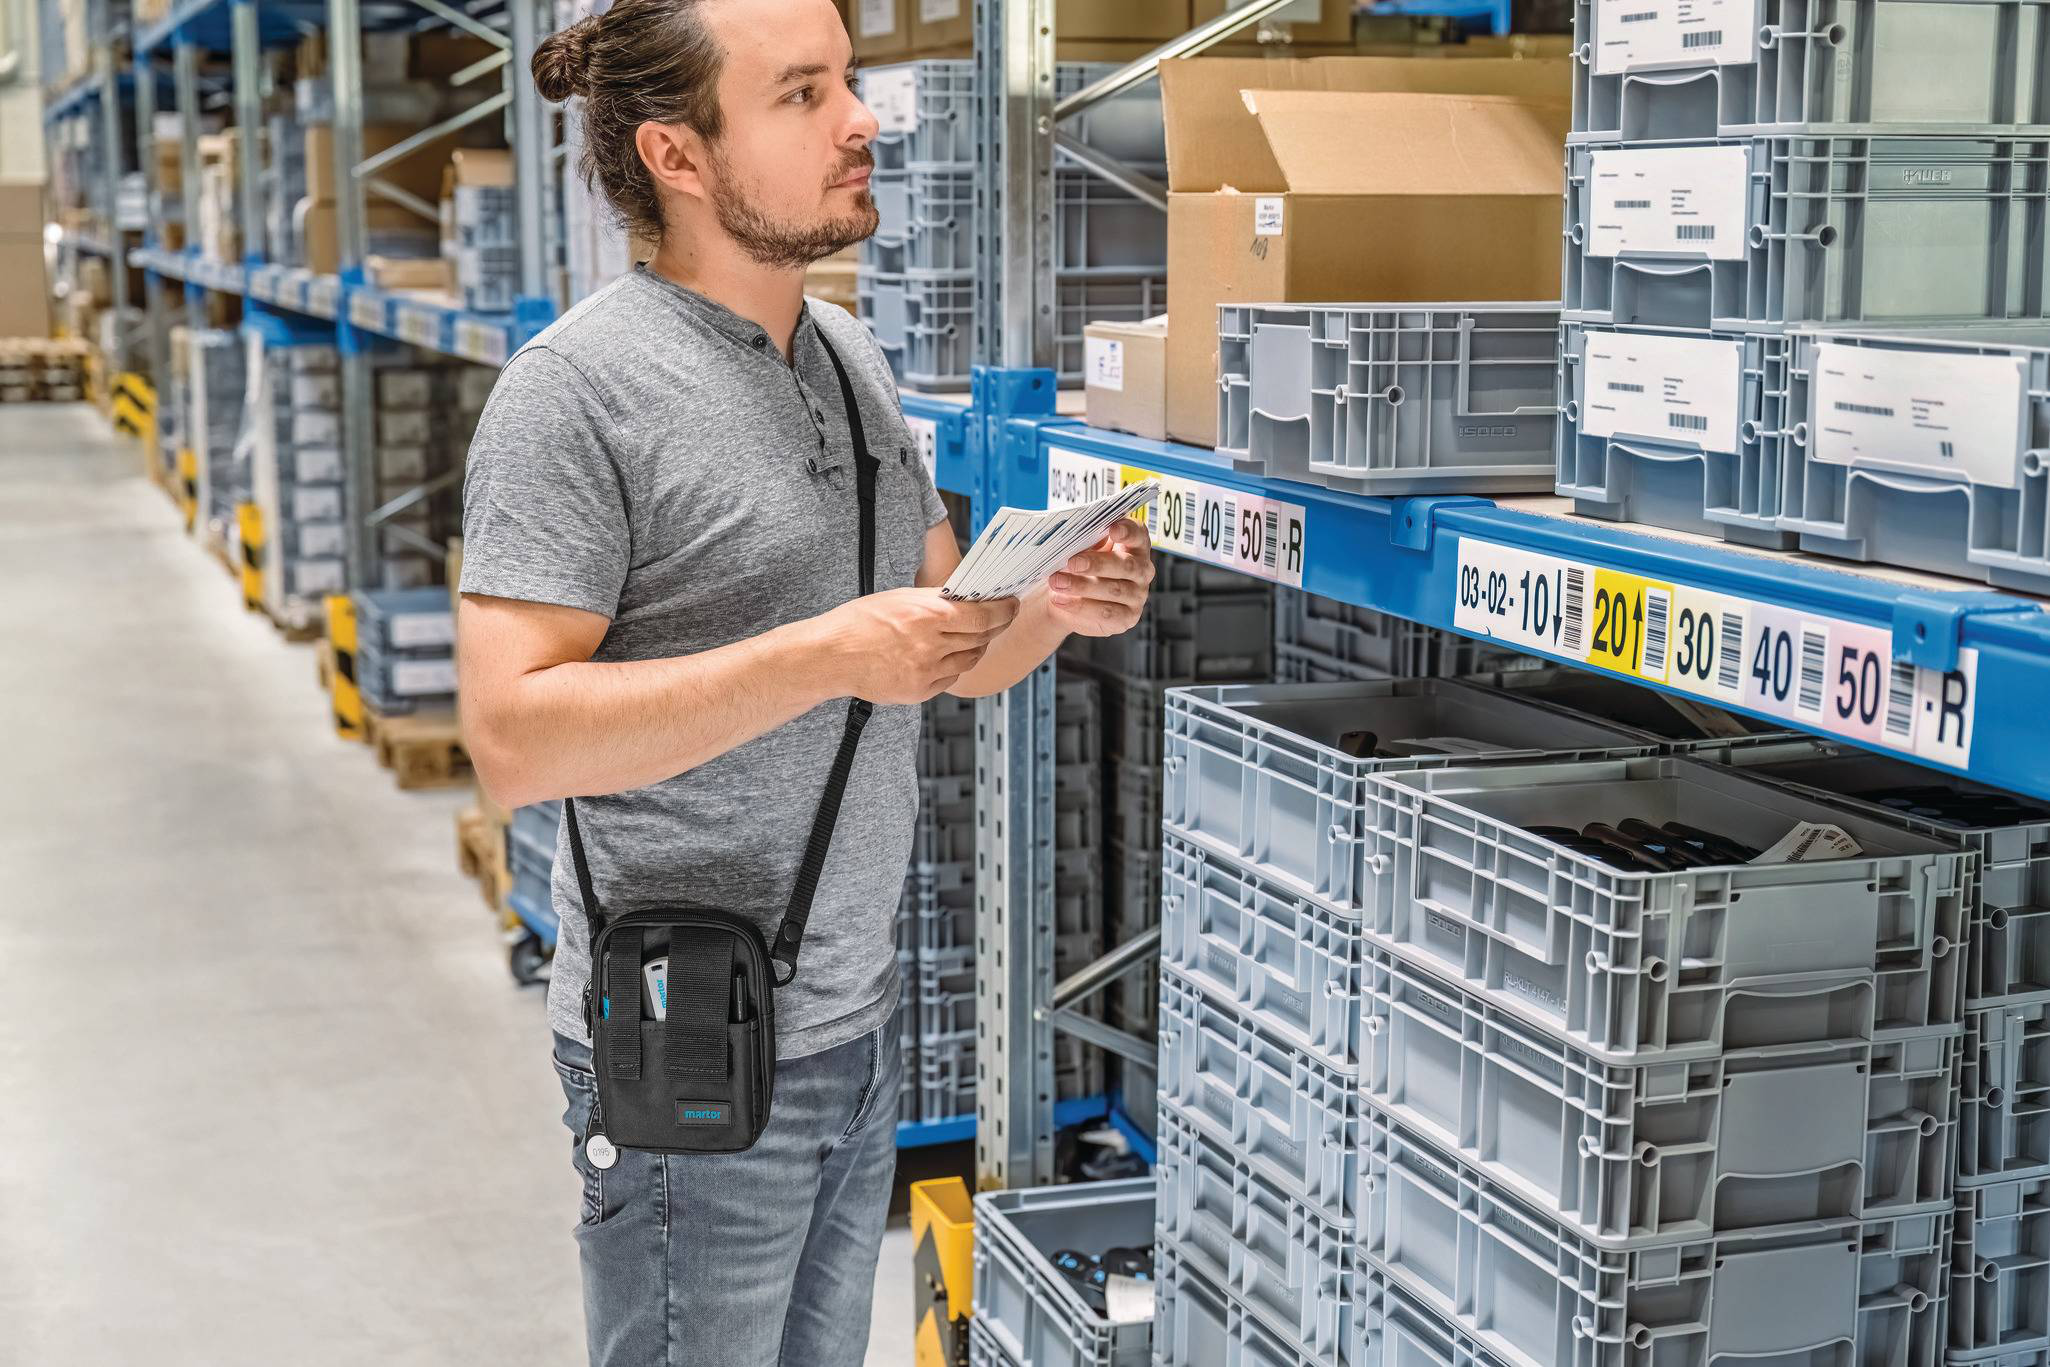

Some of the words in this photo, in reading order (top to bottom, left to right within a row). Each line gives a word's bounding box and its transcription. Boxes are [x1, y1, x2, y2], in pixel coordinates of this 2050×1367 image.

[1163, 490, 1182, 540] 30
[1201, 501, 1220, 551] 40
[1240, 509, 1262, 563] 50
[1592, 588, 1627, 657] 20
[1677, 607, 1714, 681] 30
[1752, 626, 1793, 702] 40
[1836, 646, 1881, 726] 50
[684, 1109, 721, 1119] martor
